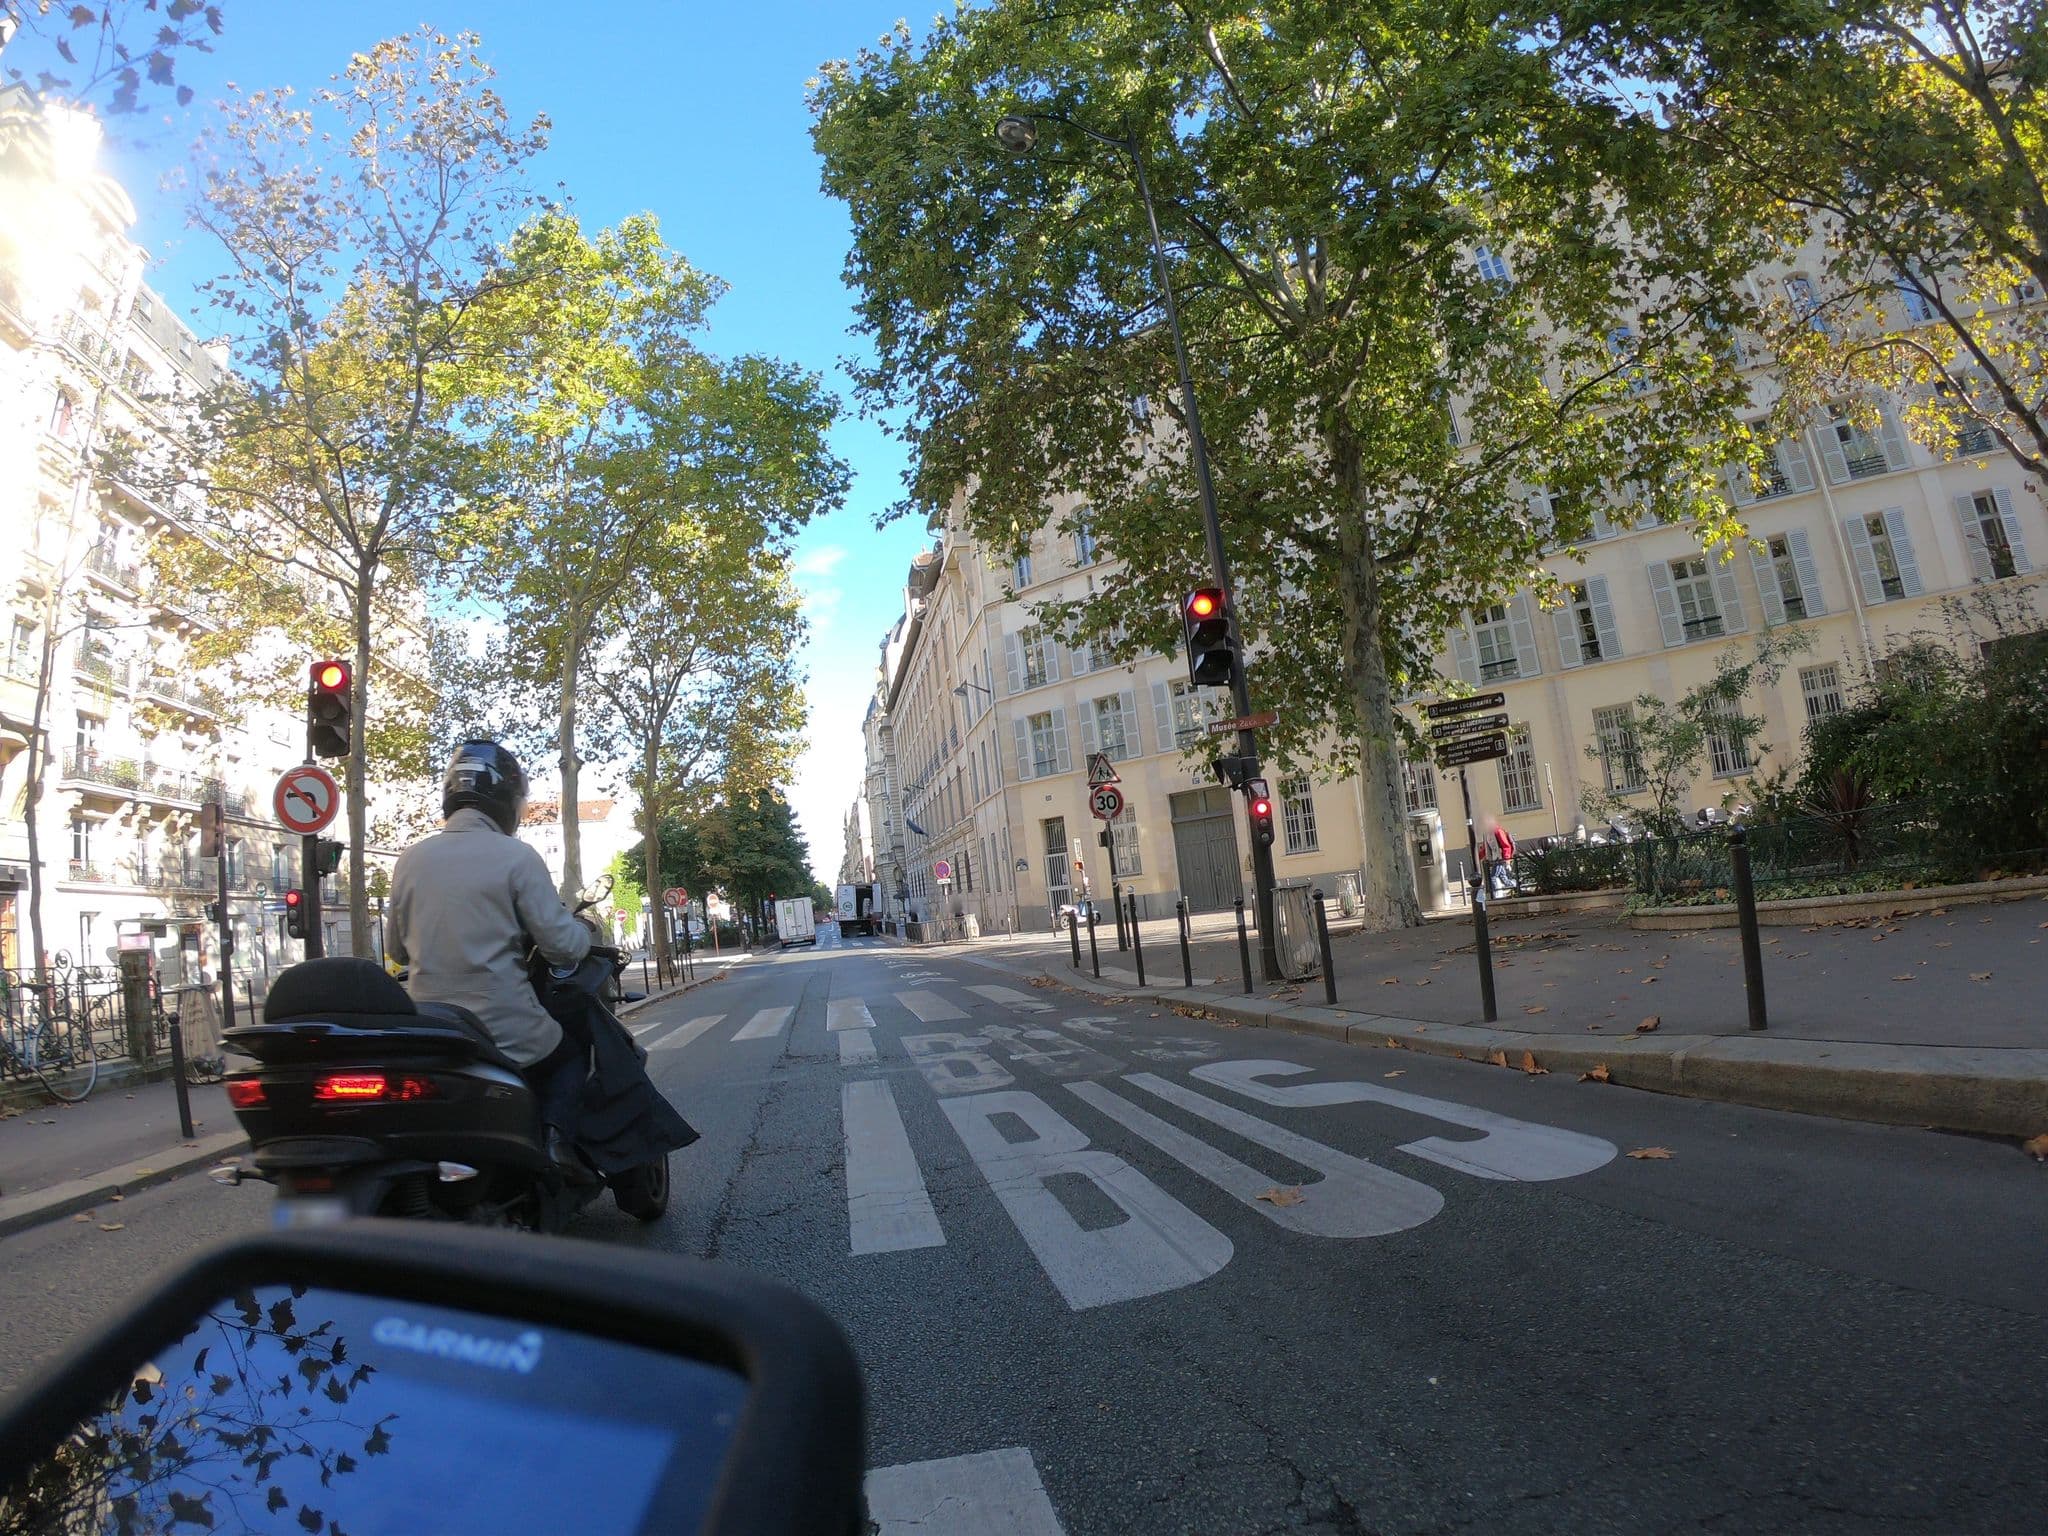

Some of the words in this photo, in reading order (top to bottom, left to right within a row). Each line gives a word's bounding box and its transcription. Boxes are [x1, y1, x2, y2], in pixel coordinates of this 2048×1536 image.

[1211, 722, 1236, 733] Musée
[1096, 792, 1118, 812] 30
[937, 1057, 1618, 1311] BUS
[372, 1317, 541, 1373] GARMIN
